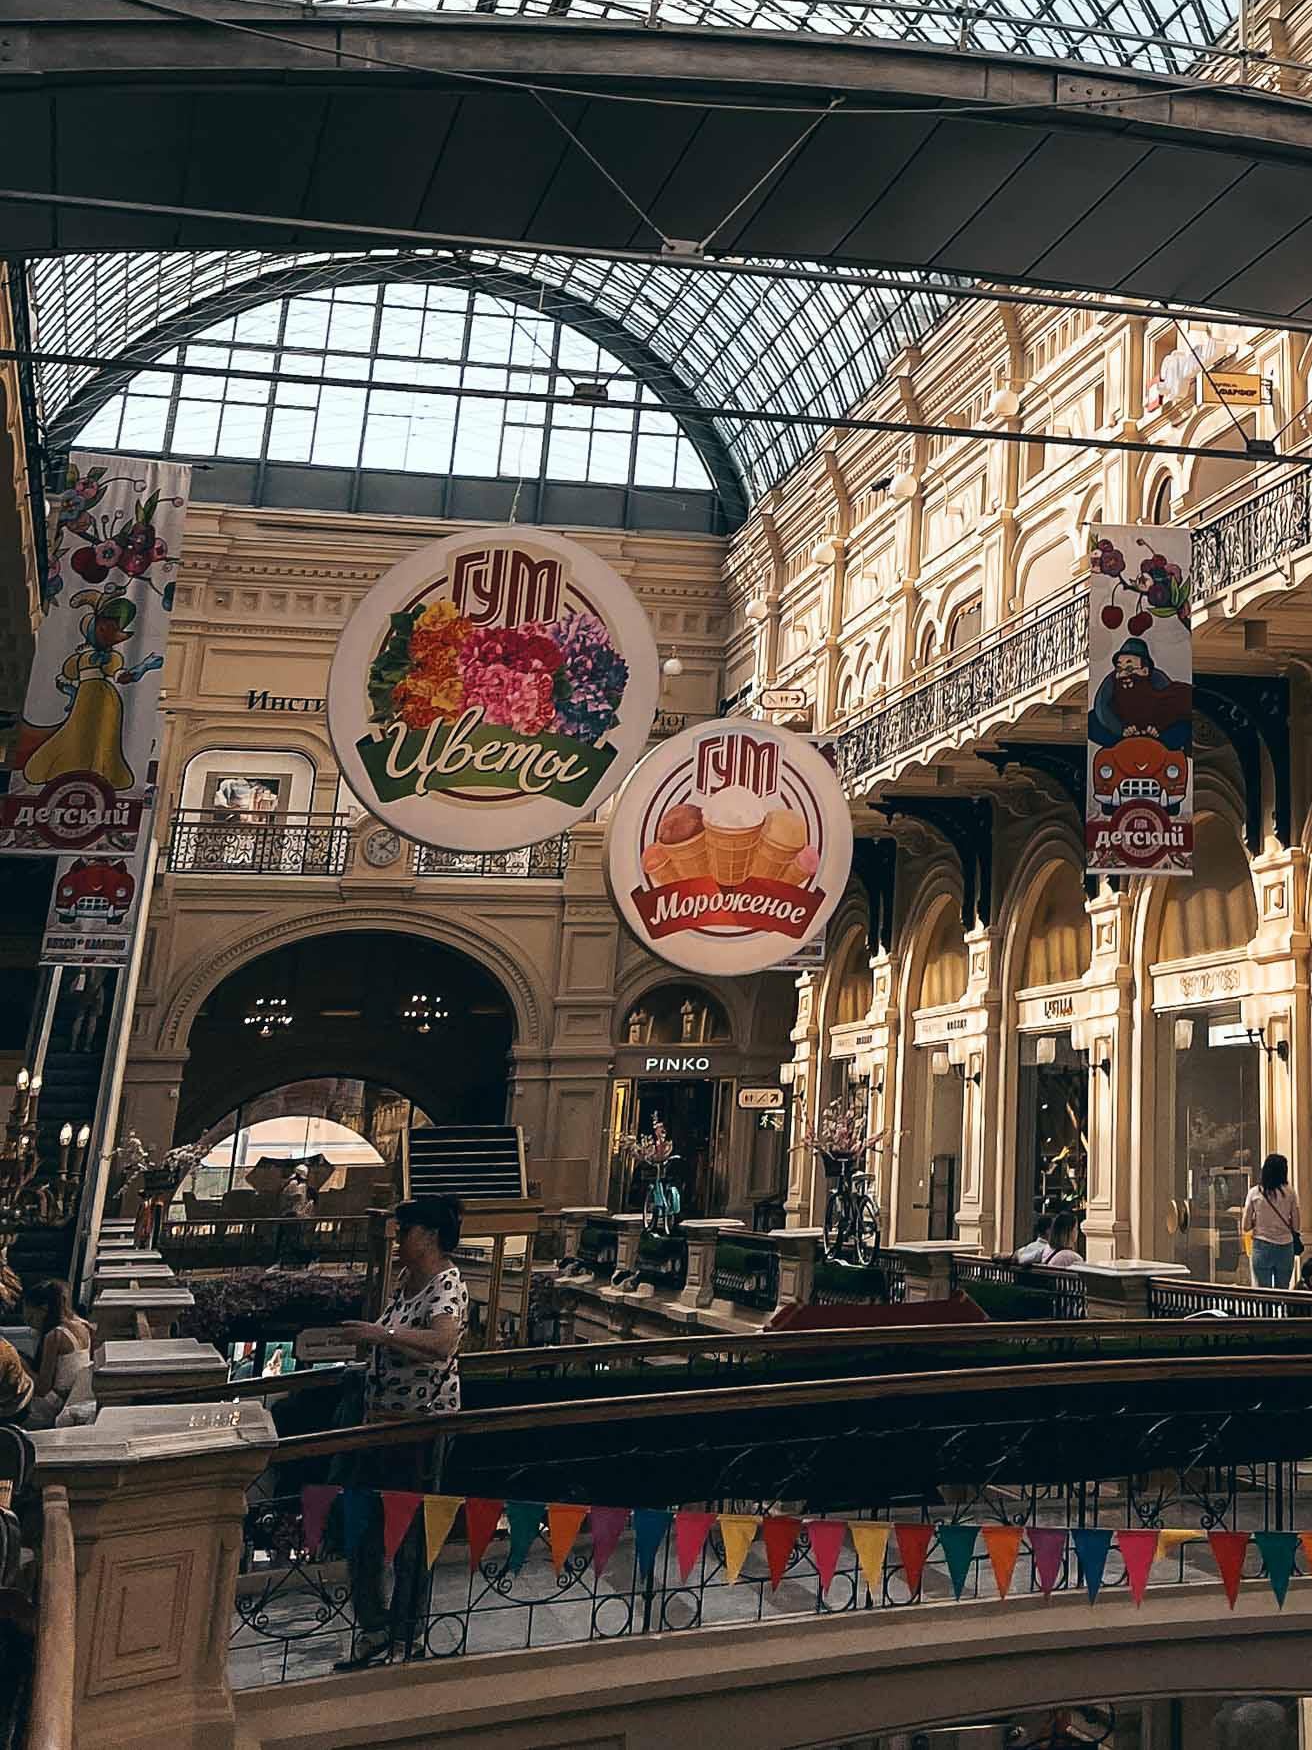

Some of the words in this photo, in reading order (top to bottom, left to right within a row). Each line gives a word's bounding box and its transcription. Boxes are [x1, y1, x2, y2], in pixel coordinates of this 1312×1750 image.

[451, 548, 563, 630] ГУМ
[385, 705, 589, 796] Цветы
[696, 733, 779, 798] ГУМ
[14, 802, 130, 826] детский
[1095, 825, 1185, 849] детский
[649, 890, 807, 926] Мороженое
[645, 1057, 710, 1071] PINKO
